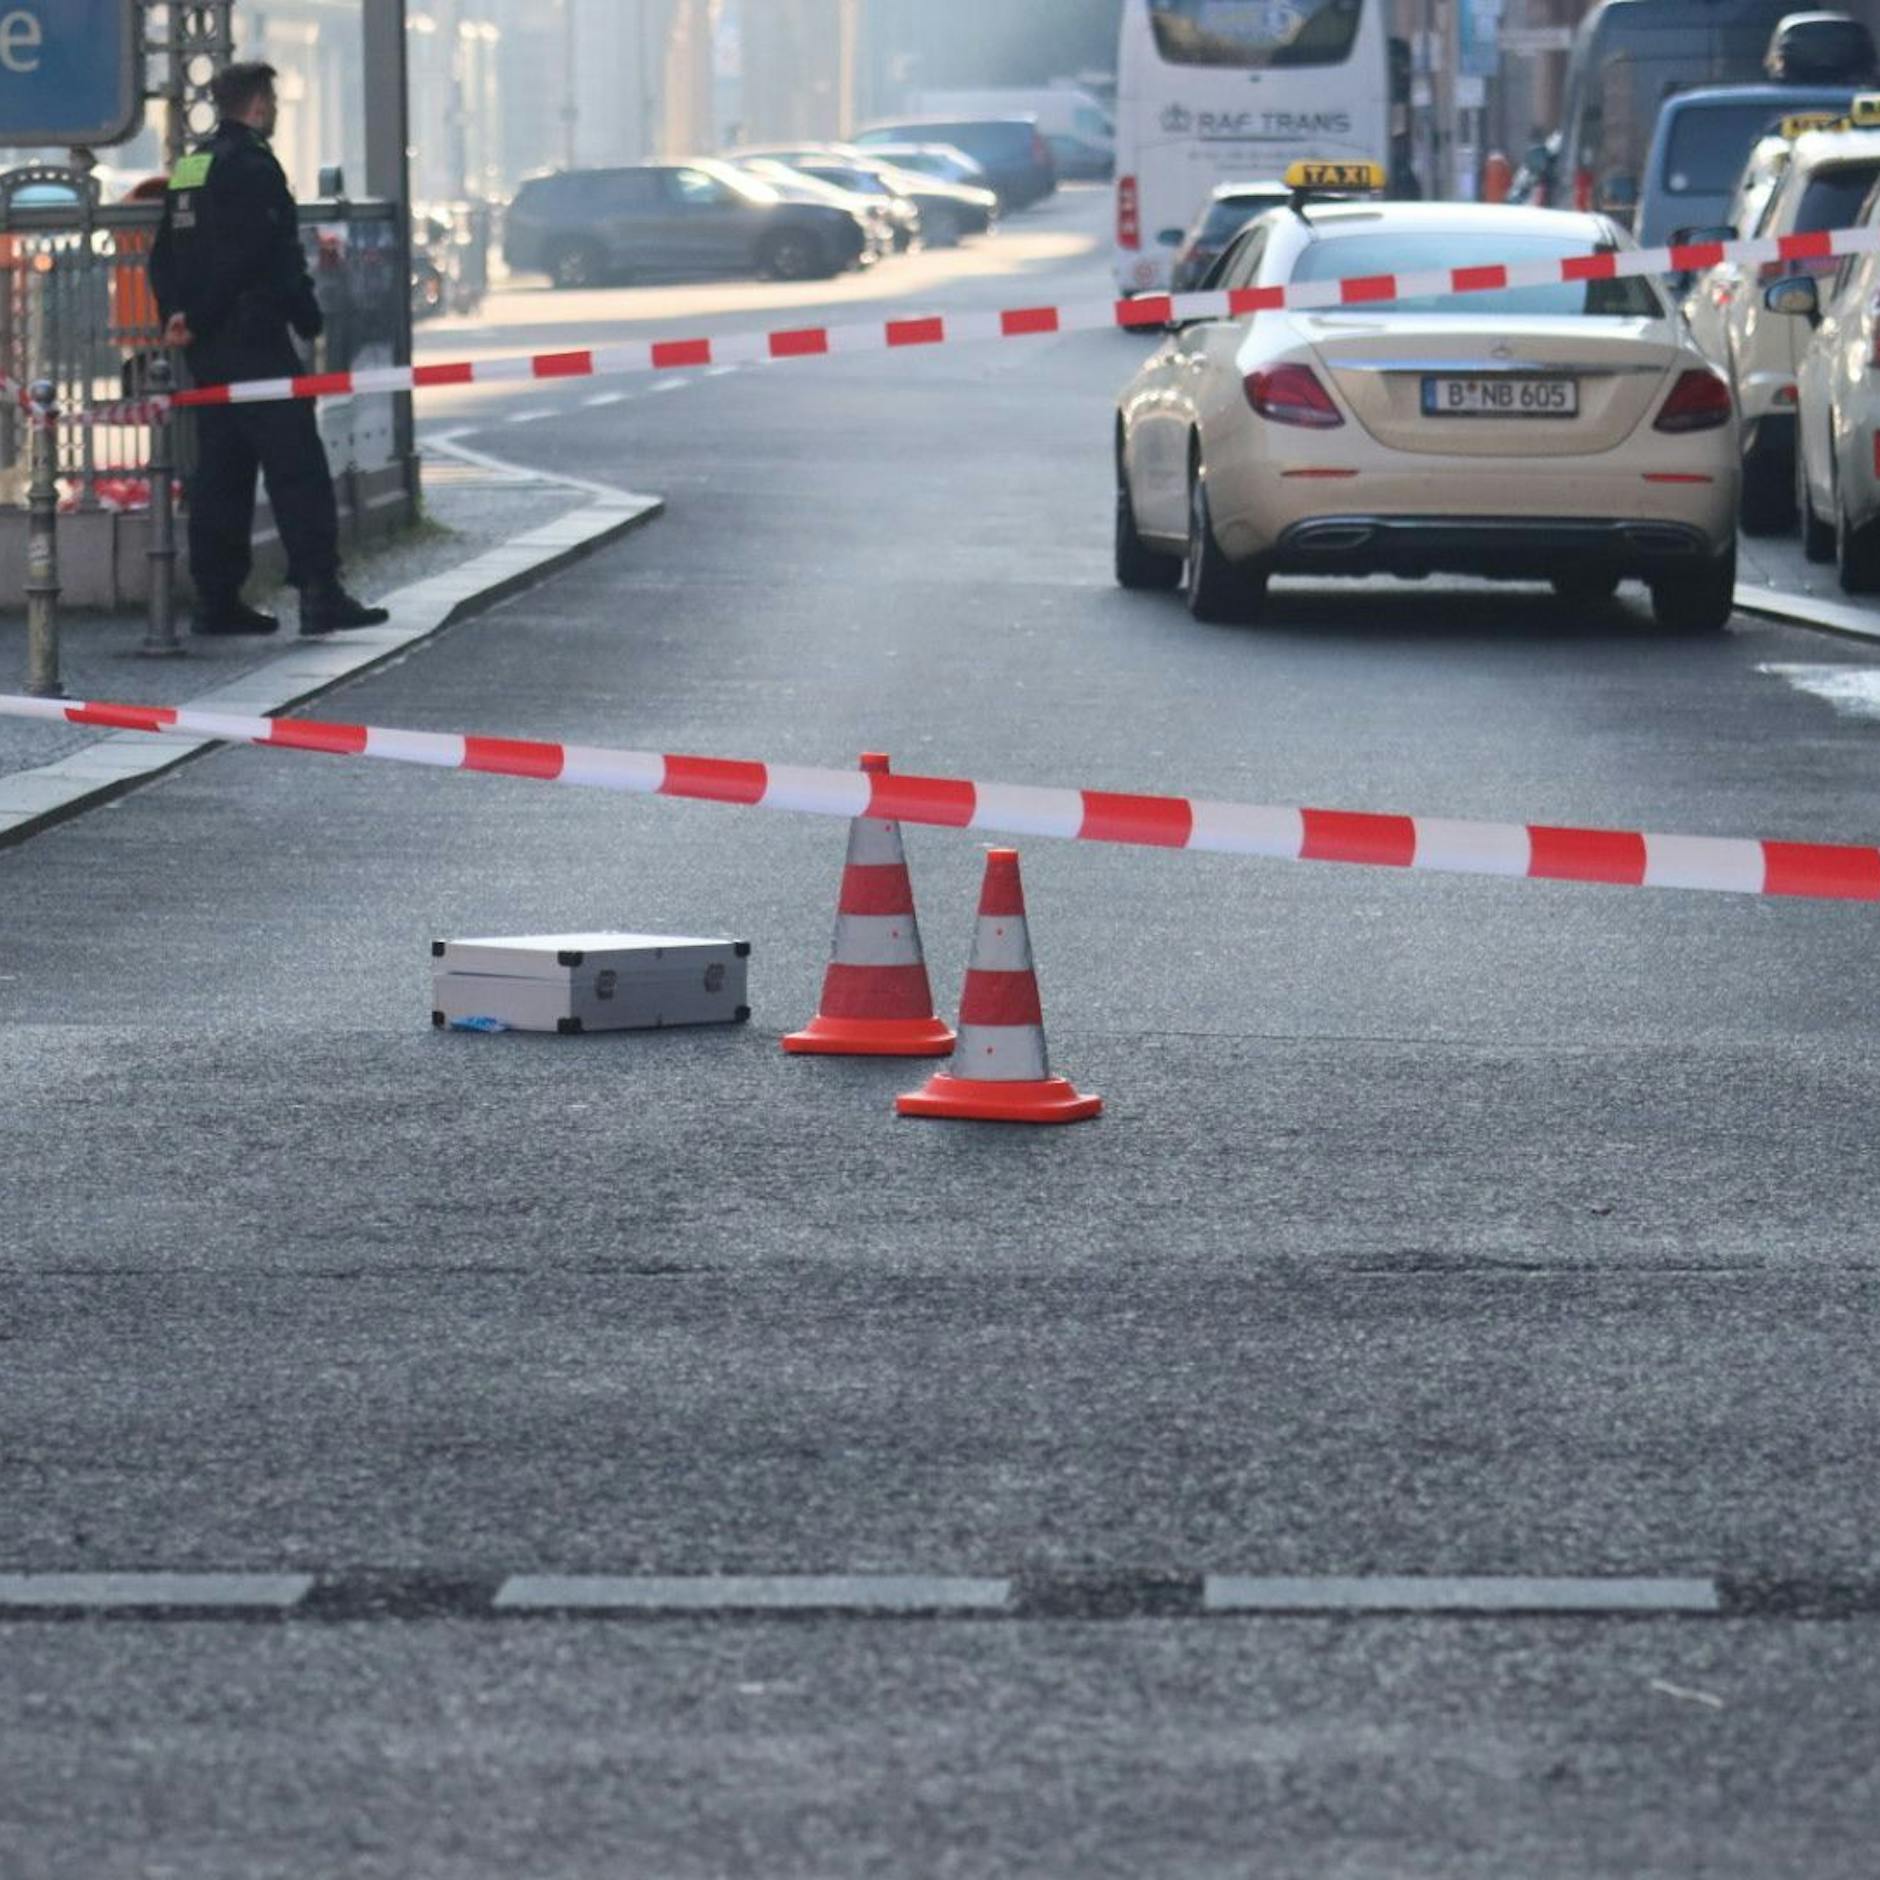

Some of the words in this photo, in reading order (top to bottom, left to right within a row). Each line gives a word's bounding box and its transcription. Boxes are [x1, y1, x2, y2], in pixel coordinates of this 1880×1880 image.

[1199, 113, 1252, 132] RAF
[1261, 113, 1351, 132] TRANS
[1306, 164, 1368, 185] TAXI
[1520, 384, 1566, 407] 605
